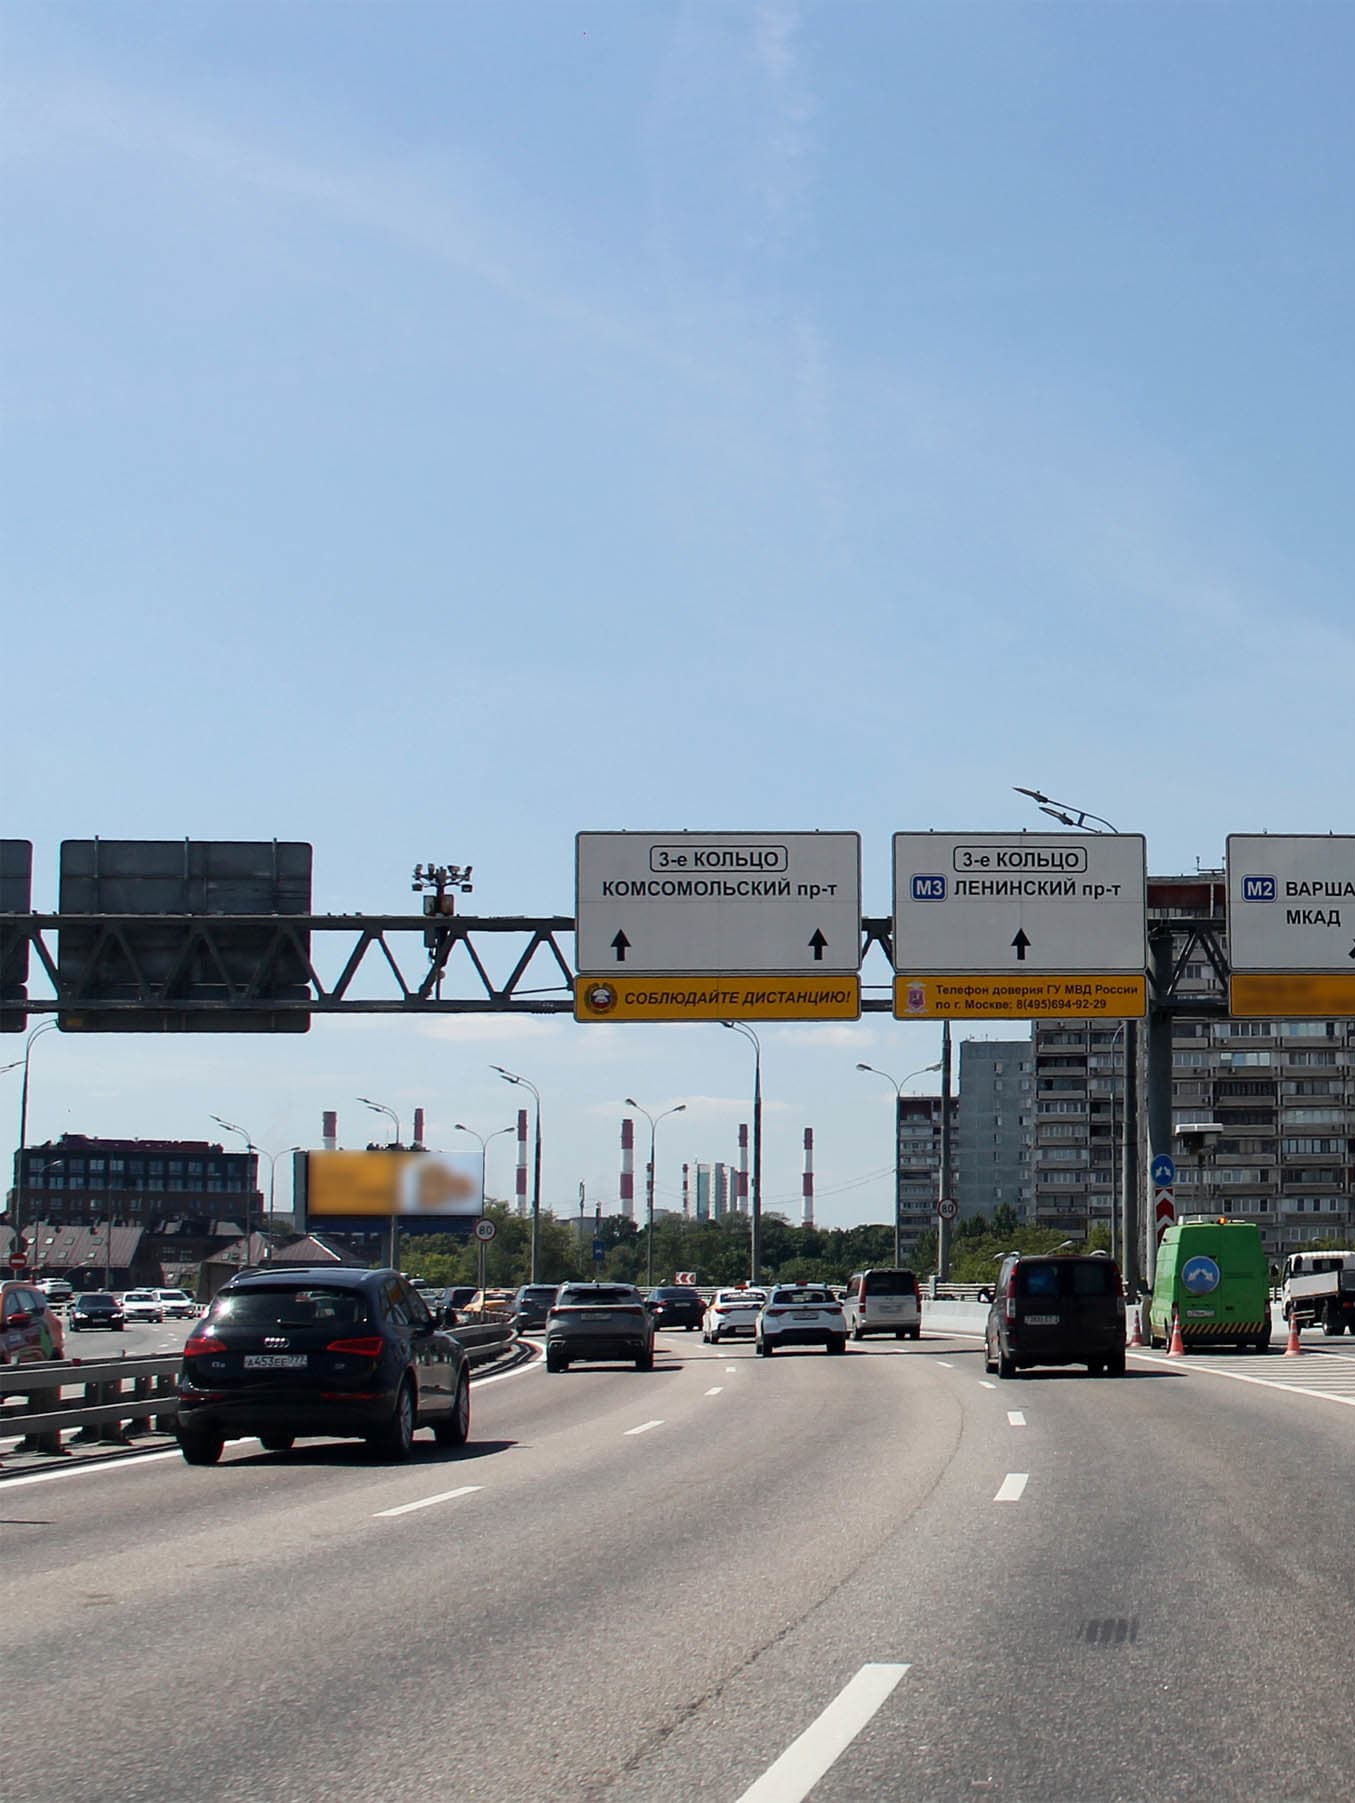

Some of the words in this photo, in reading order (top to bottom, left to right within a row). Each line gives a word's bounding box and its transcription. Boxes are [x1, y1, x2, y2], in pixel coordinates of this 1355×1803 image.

[658, 852, 688, 868] 3-е
[694, 851, 779, 869] КОЛЬЦО
[962, 853, 991, 868] 3-е
[996, 852, 1079, 870] КОЛЬЦО
[603, 878, 791, 897] КОМСОМОЛЬСКИЙ
[797, 884, 838, 899] пр-т
[916, 882, 944, 897] М3
[954, 878, 1076, 896] ЛЕНИНСКИЙ
[1082, 885, 1121, 899] пр-т
[1246, 882, 1274, 897] М2
[1286, 910, 1341, 927] МКАД
[624, 990, 740, 1007] СОБЛЮДАЙТЕ
[742, 990, 851, 1006] ДИСТАНЦИЮ!
[935, 984, 989, 996] Телефон
[992, 986, 1043, 997] доверия
[1047, 985, 1062, 996] ГУ
[1064, 984, 1092, 997] МВД
[1095, 984, 1138, 995] России
[935, 1001, 950, 1010] по
[965, 1000, 1013, 1010] Москве:
[479, 1225, 493, 1236] 80
